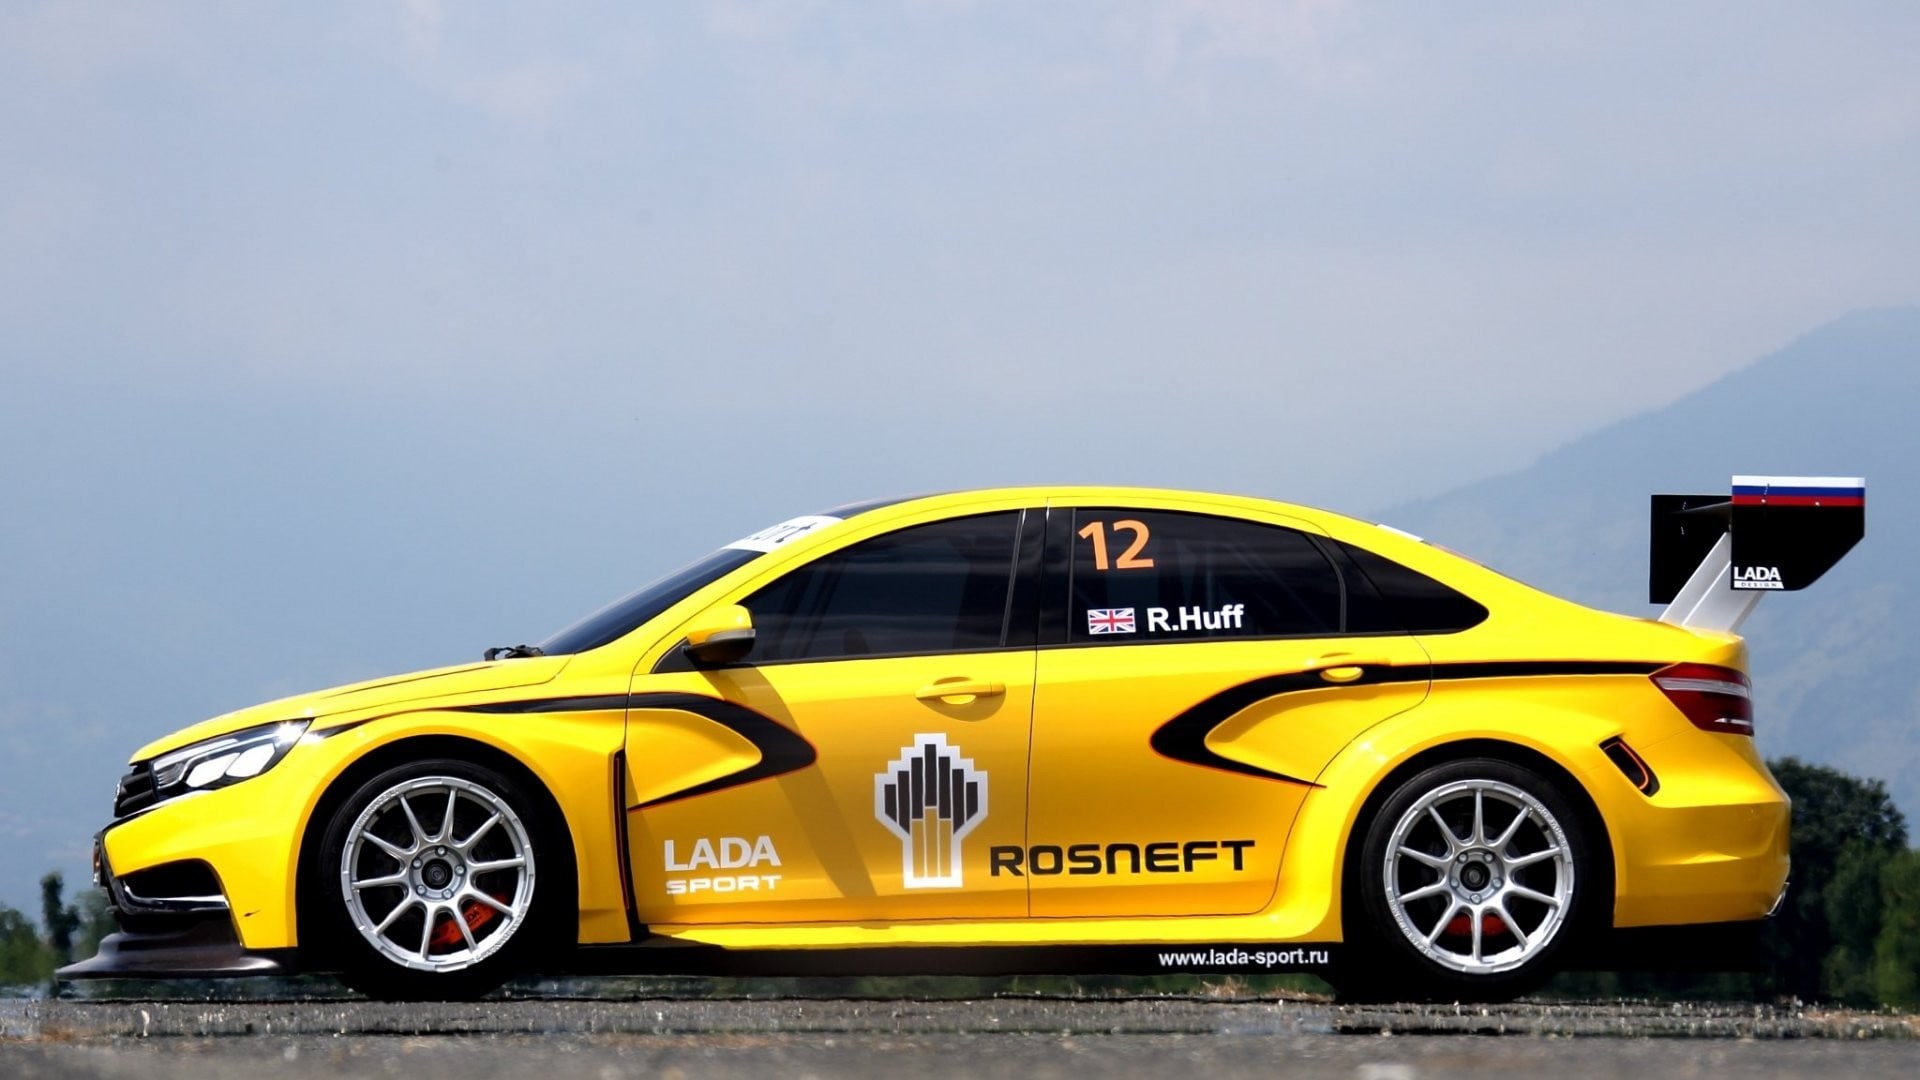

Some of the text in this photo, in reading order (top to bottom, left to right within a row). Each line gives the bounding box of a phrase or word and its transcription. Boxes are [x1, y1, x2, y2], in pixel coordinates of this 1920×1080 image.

[1078, 519, 1154, 570] 12
[1733, 566, 1781, 580] LADA
[1147, 604, 1244, 632] R.Huff
[664, 835, 782, 872] LADA
[990, 840, 1255, 877] ROSNEFT
[666, 875, 782, 895] SPORT
[1158, 948, 1329, 968] www.lada-sport.ru
